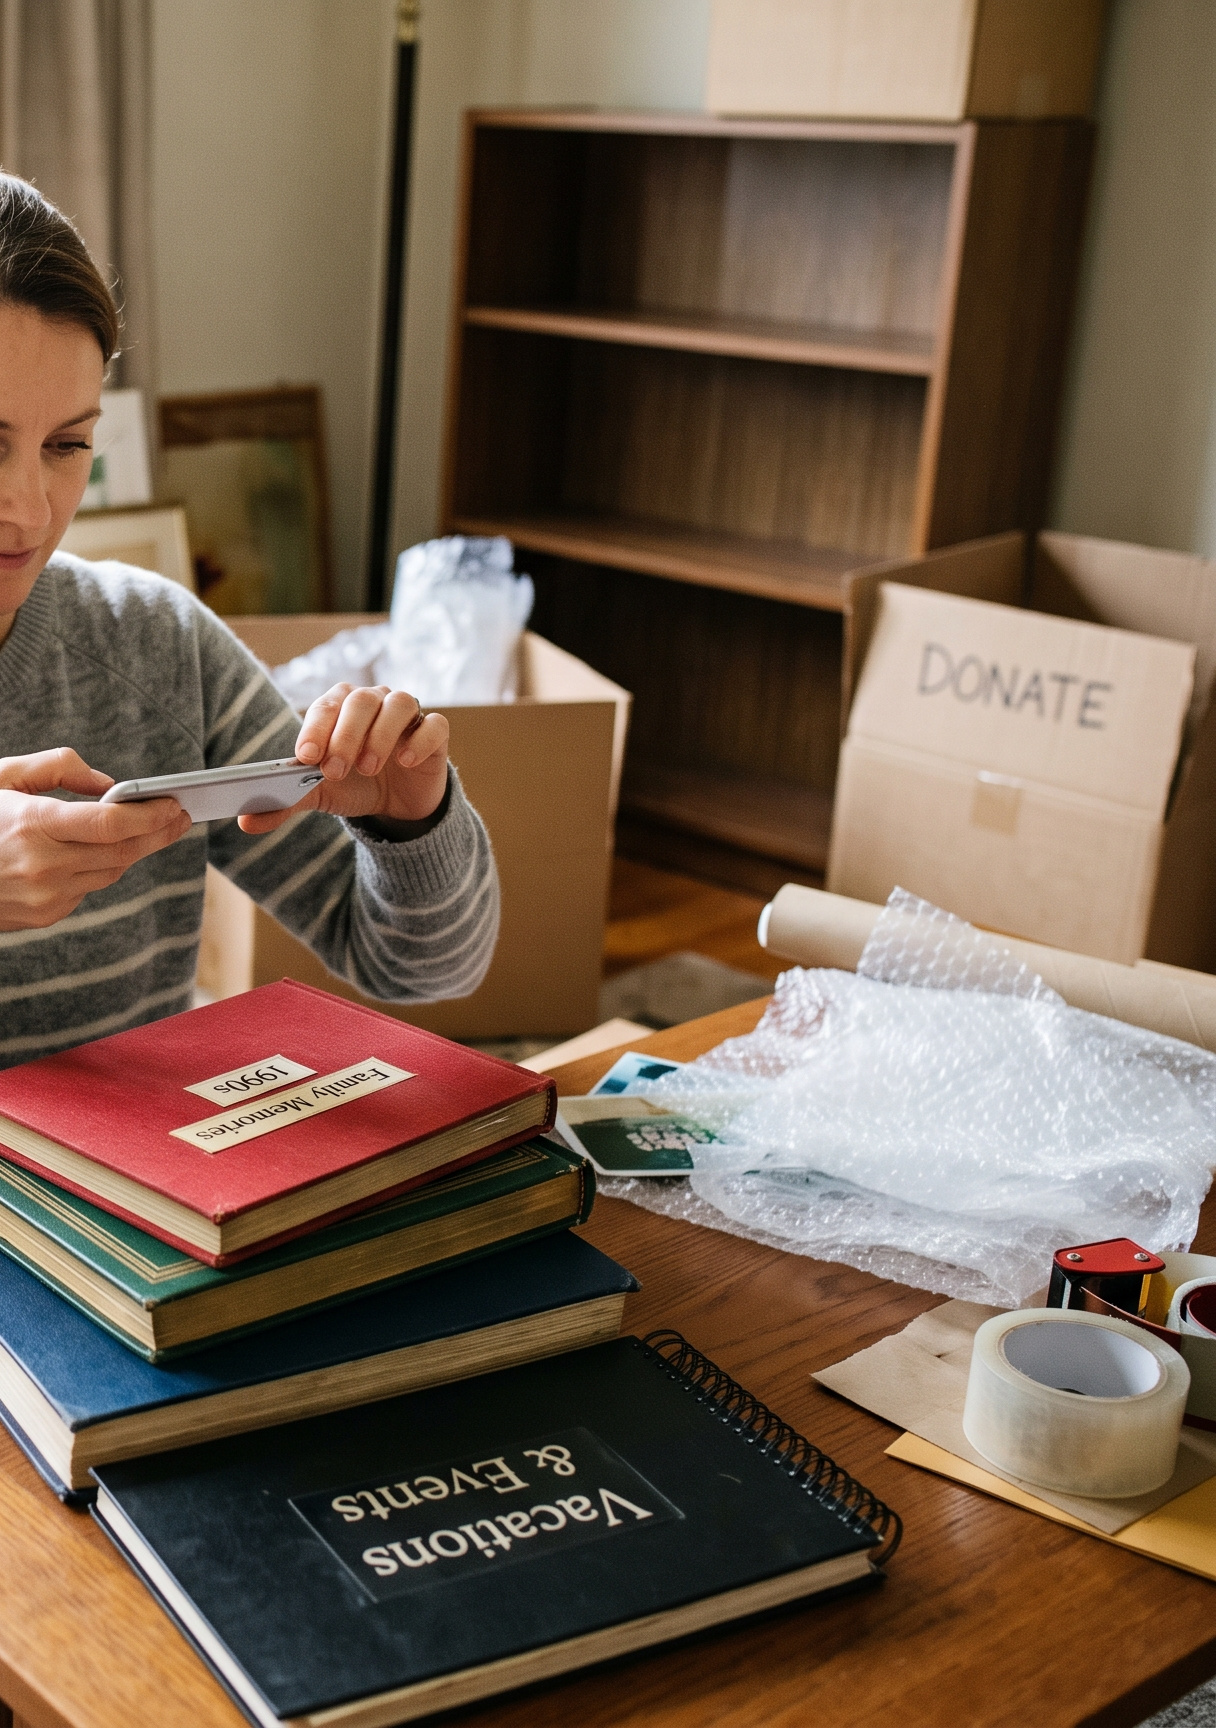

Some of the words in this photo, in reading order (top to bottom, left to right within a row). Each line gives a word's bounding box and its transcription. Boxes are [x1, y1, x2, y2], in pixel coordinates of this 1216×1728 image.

[918, 642, 1113, 729] DONATE
[213, 1064, 289, 1094] 1990s
[311, 1067, 391, 1099] Family
[195, 1096, 315, 1141] Memories
[522, 1444, 576, 1476] &
[331, 1456, 530, 1522] Events
[361, 1487, 654, 1577] Vacations
